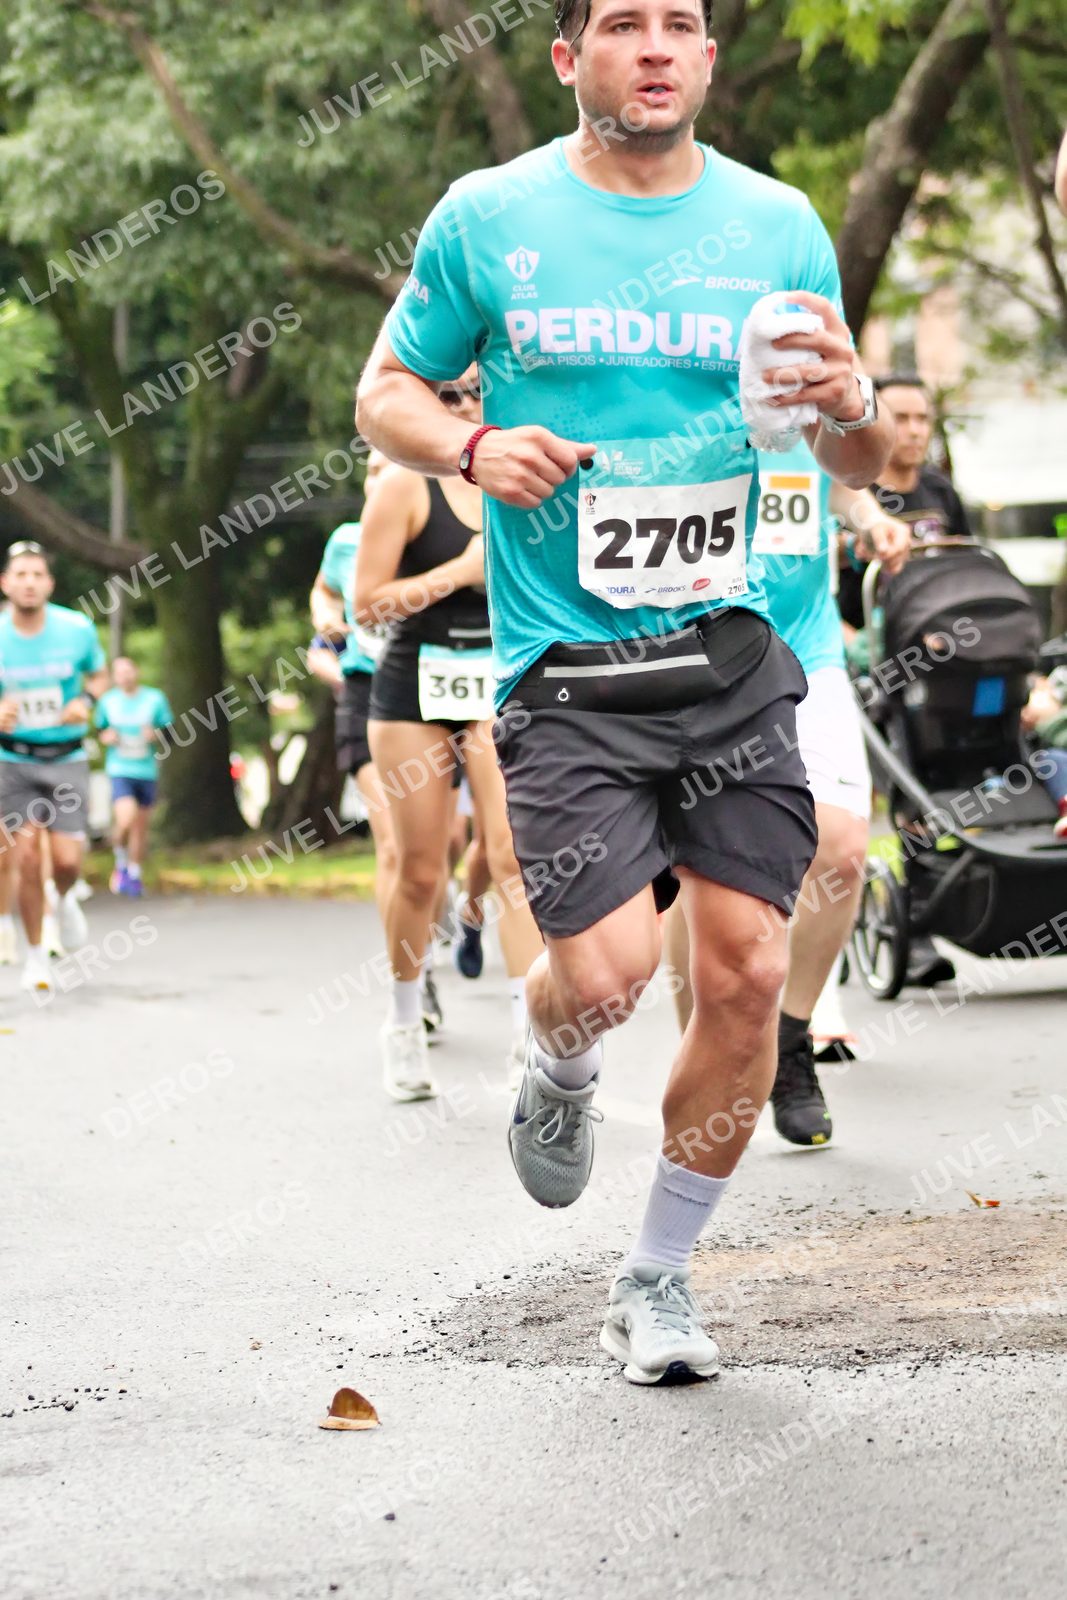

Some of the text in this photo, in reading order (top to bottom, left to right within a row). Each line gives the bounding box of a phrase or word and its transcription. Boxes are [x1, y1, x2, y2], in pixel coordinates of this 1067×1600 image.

[512, 284, 536, 292] CLUB
[705, 276, 771, 293] BROOKS
[511, 291, 539, 300] ATLAS
[557, 355, 596, 366] PISOS
[606, 356, 691, 369] JUNTEADORES
[761, 494, 811, 524] 80
[593, 506, 736, 569] 2705
[429, 674, 486, 700] 361
